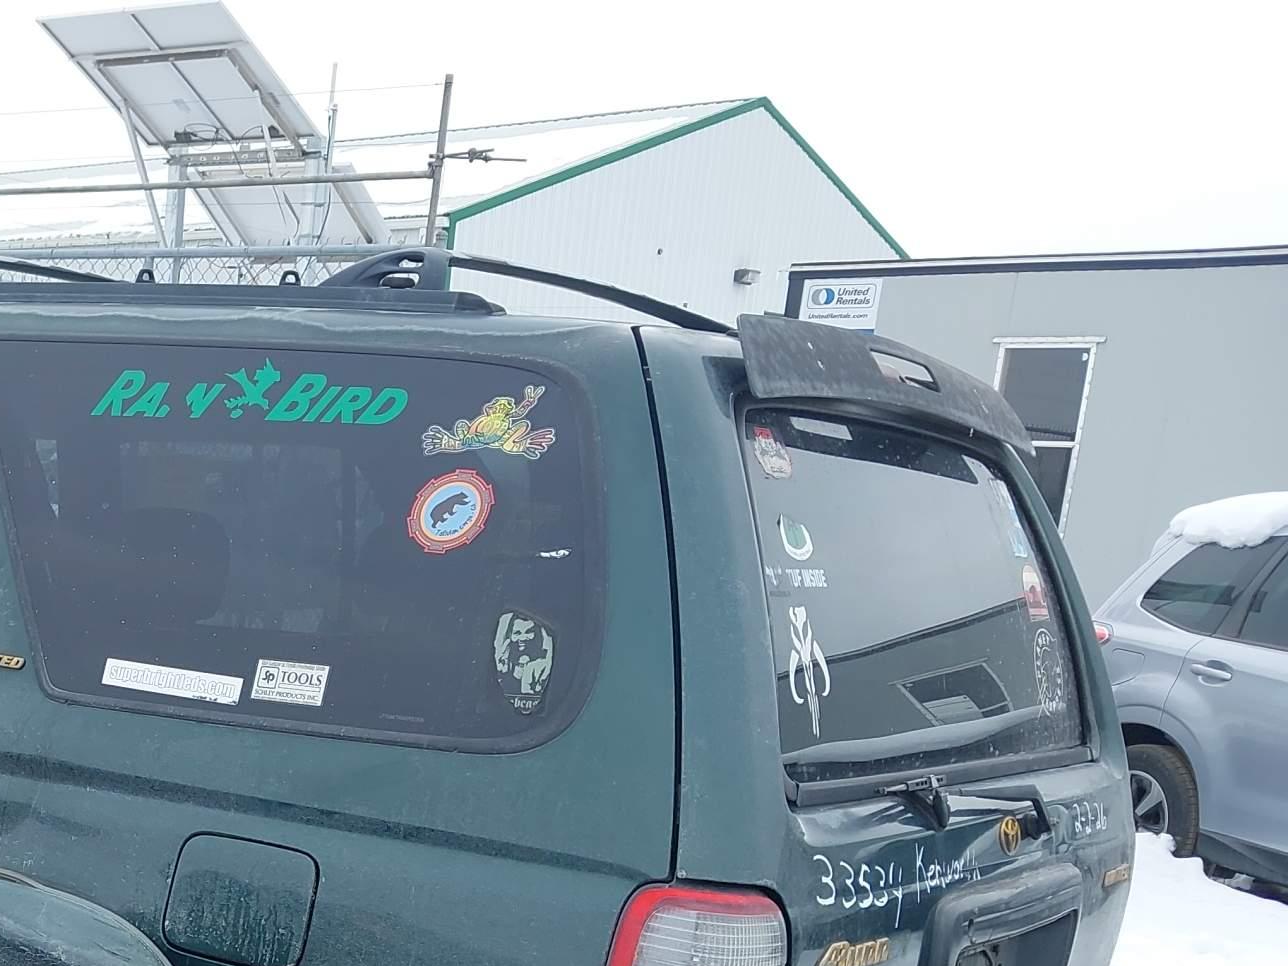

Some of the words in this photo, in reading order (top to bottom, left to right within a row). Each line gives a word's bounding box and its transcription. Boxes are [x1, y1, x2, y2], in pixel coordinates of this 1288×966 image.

[837, 287, 870, 297] United
[835, 297, 871, 305] Rentals
[264, 373, 409, 425] BIRD
[110, 664, 236, 698] superbrightleds.com
[281, 670, 323, 687] TOOLS
[275, 690, 306, 701] PRODUCTS
[1072, 801, 1107, 834] 2-2-26
